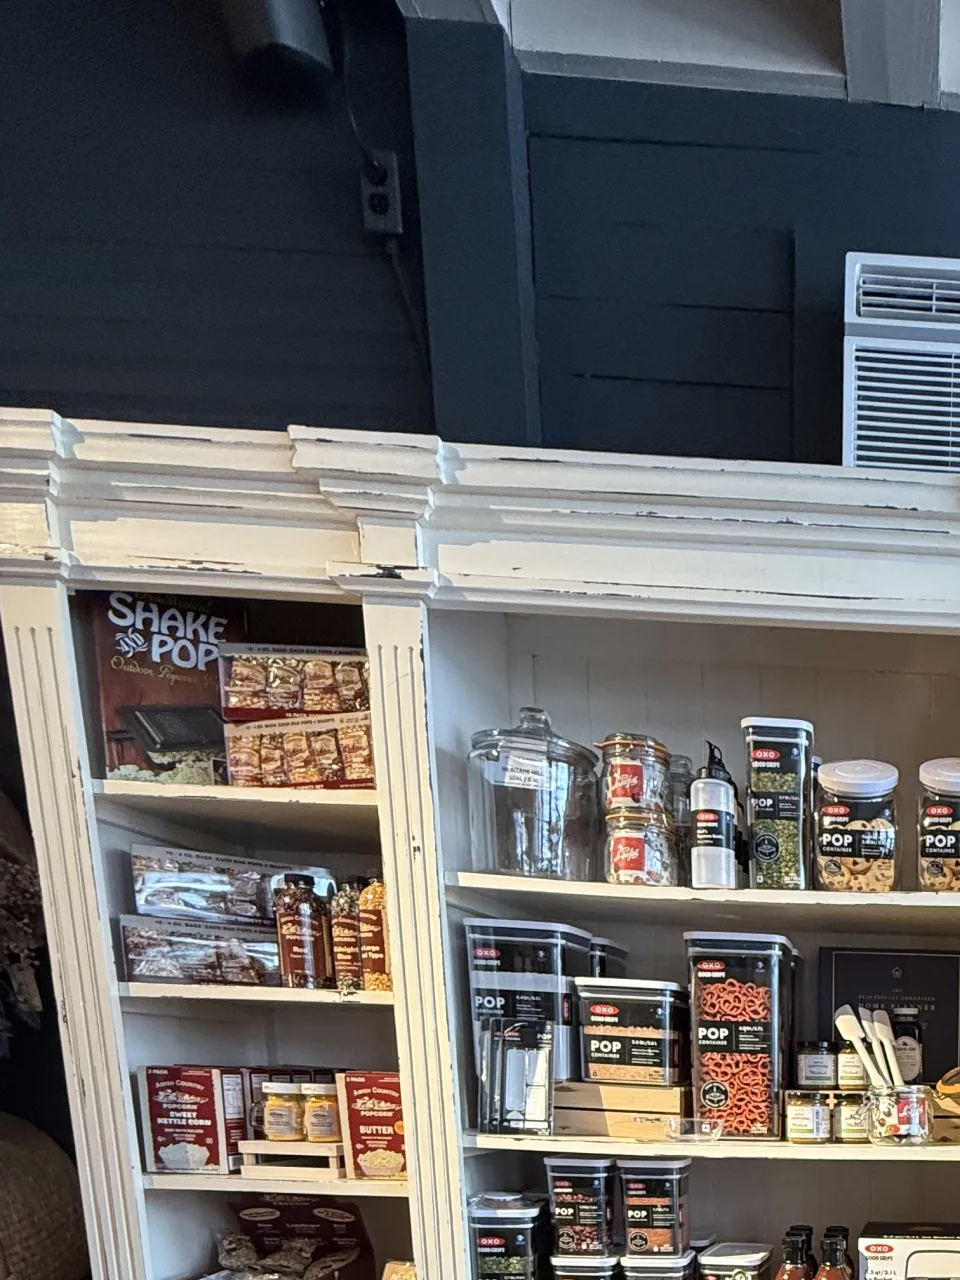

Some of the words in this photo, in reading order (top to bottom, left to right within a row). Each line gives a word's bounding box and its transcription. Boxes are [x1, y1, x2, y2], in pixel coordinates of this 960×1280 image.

[107, 591, 229, 644] SHAKE
[151, 633, 219, 671] POP
[751, 797, 774, 807] POP
[822, 833, 854, 847] POP
[925, 835, 956, 848] POP
[477, 949, 496, 957] OXO
[475, 995, 506, 1009] POP
[858, 1002, 888, 1010] HOME
[890, 1003, 936, 1011] PLANNER
[595, 1006, 614, 1014] OXO
[698, 1027, 729, 1040] POP
[590, 1040, 622, 1053] POP
[175, 1079, 206, 1091] COUNTRY
[353, 1088, 372, 1097] AMISH
[371, 1086, 400, 1098] COUNTRY
[157, 1117, 187, 1126] KETTLE
[187, 1118, 212, 1126] CORN
[359, 1125, 394, 1135] BUTTER
[555, 1207, 574, 1216] POP
[627, 1210, 648, 1219] POP
[869, 1244, 890, 1253] OXO
